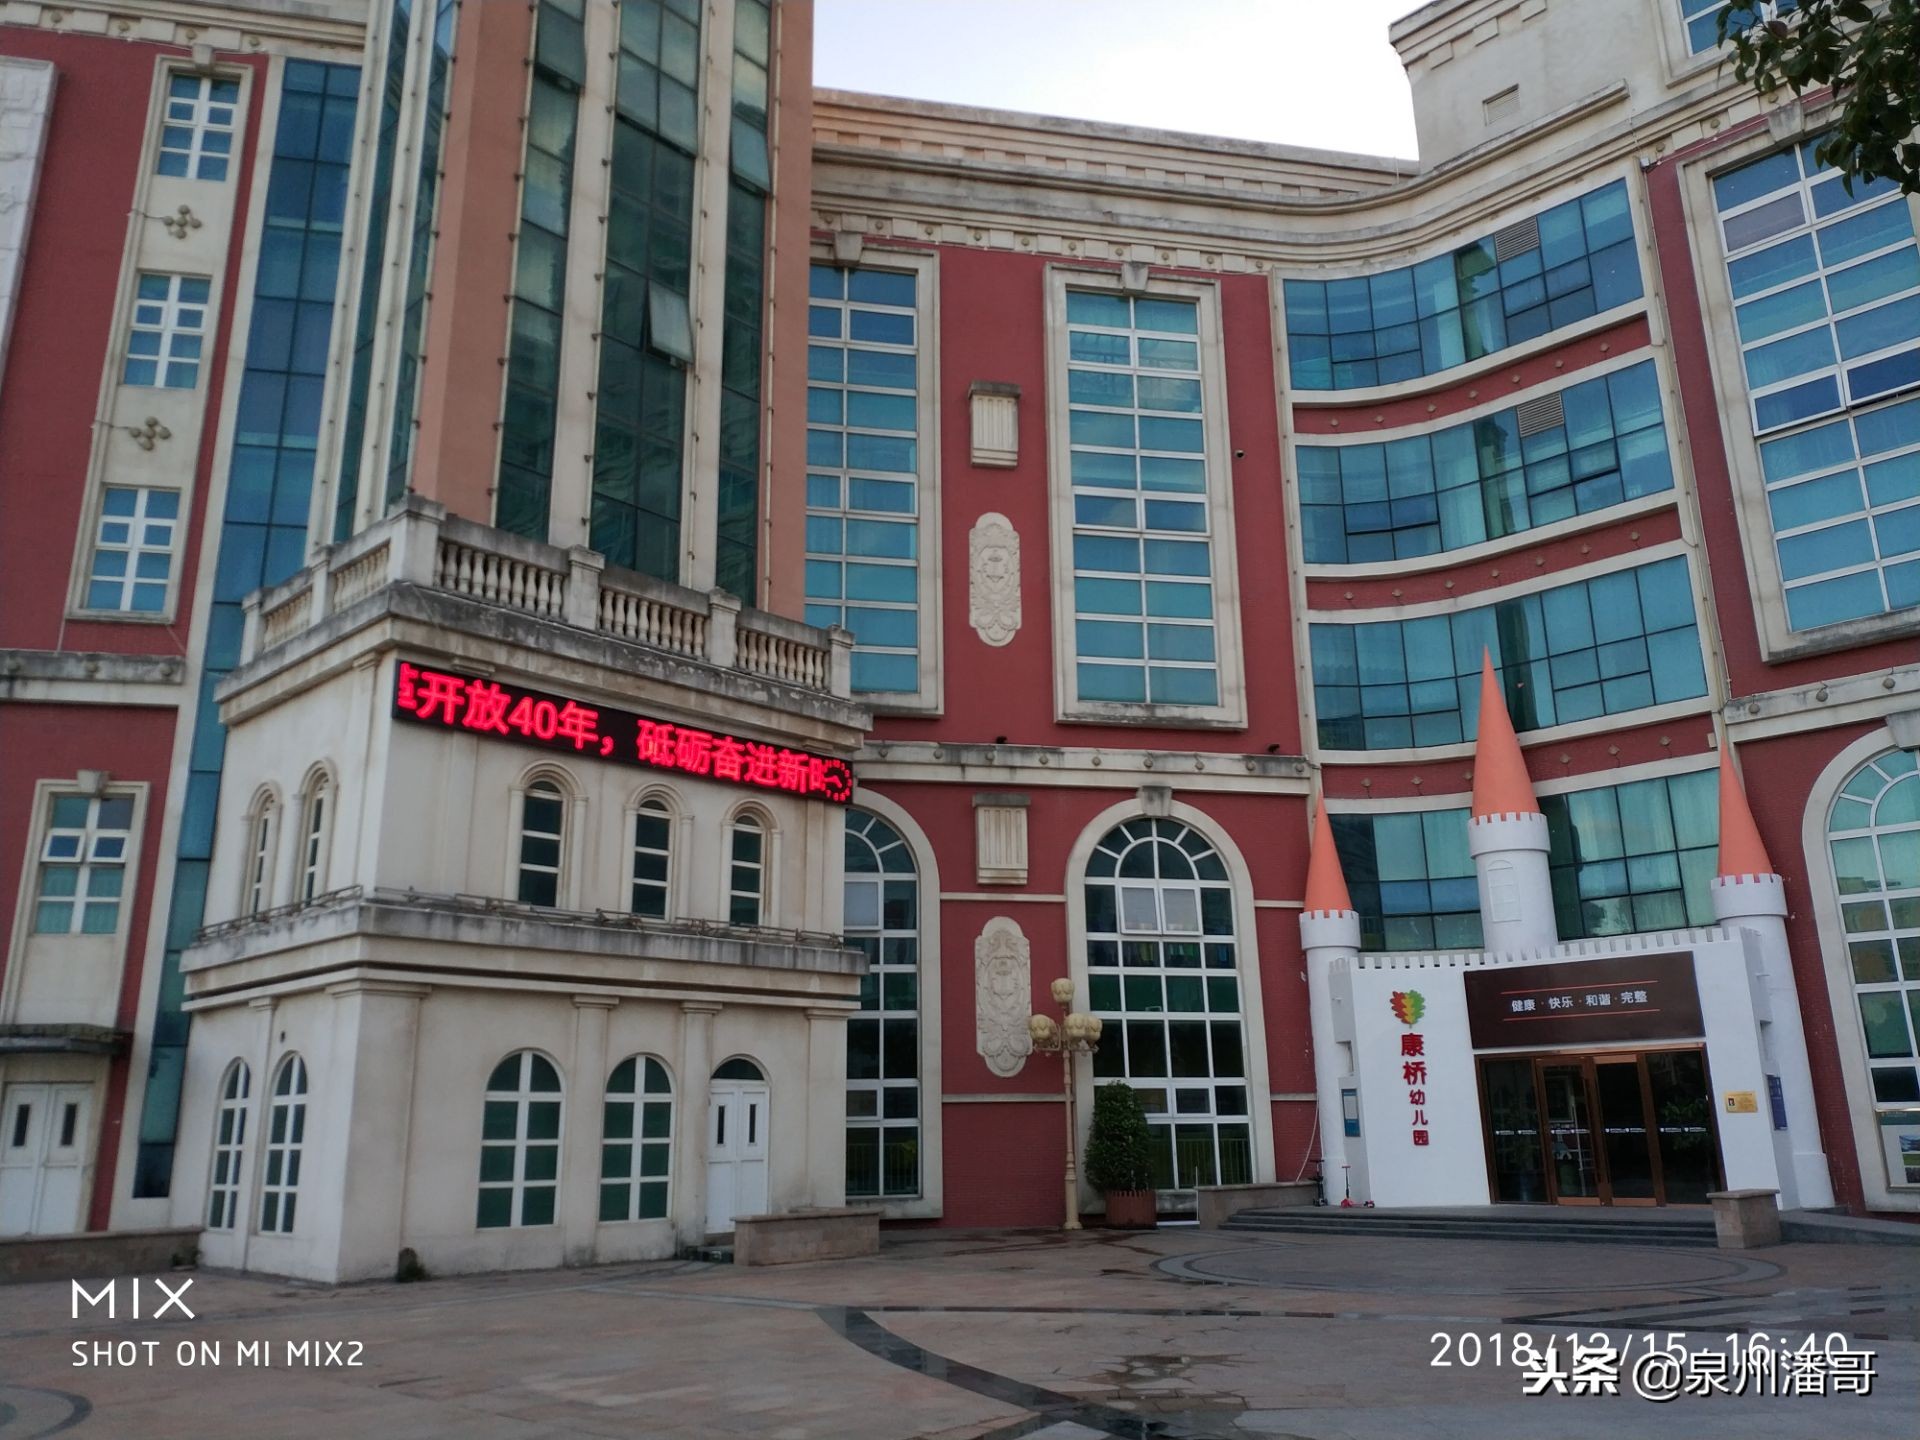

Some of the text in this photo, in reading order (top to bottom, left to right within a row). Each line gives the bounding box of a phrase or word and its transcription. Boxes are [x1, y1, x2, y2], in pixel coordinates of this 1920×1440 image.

[1511, 991, 1647, 1012] 健康 快乐 和谐 完整
[1401, 1033, 1429, 1146] 康桥幼儿园
